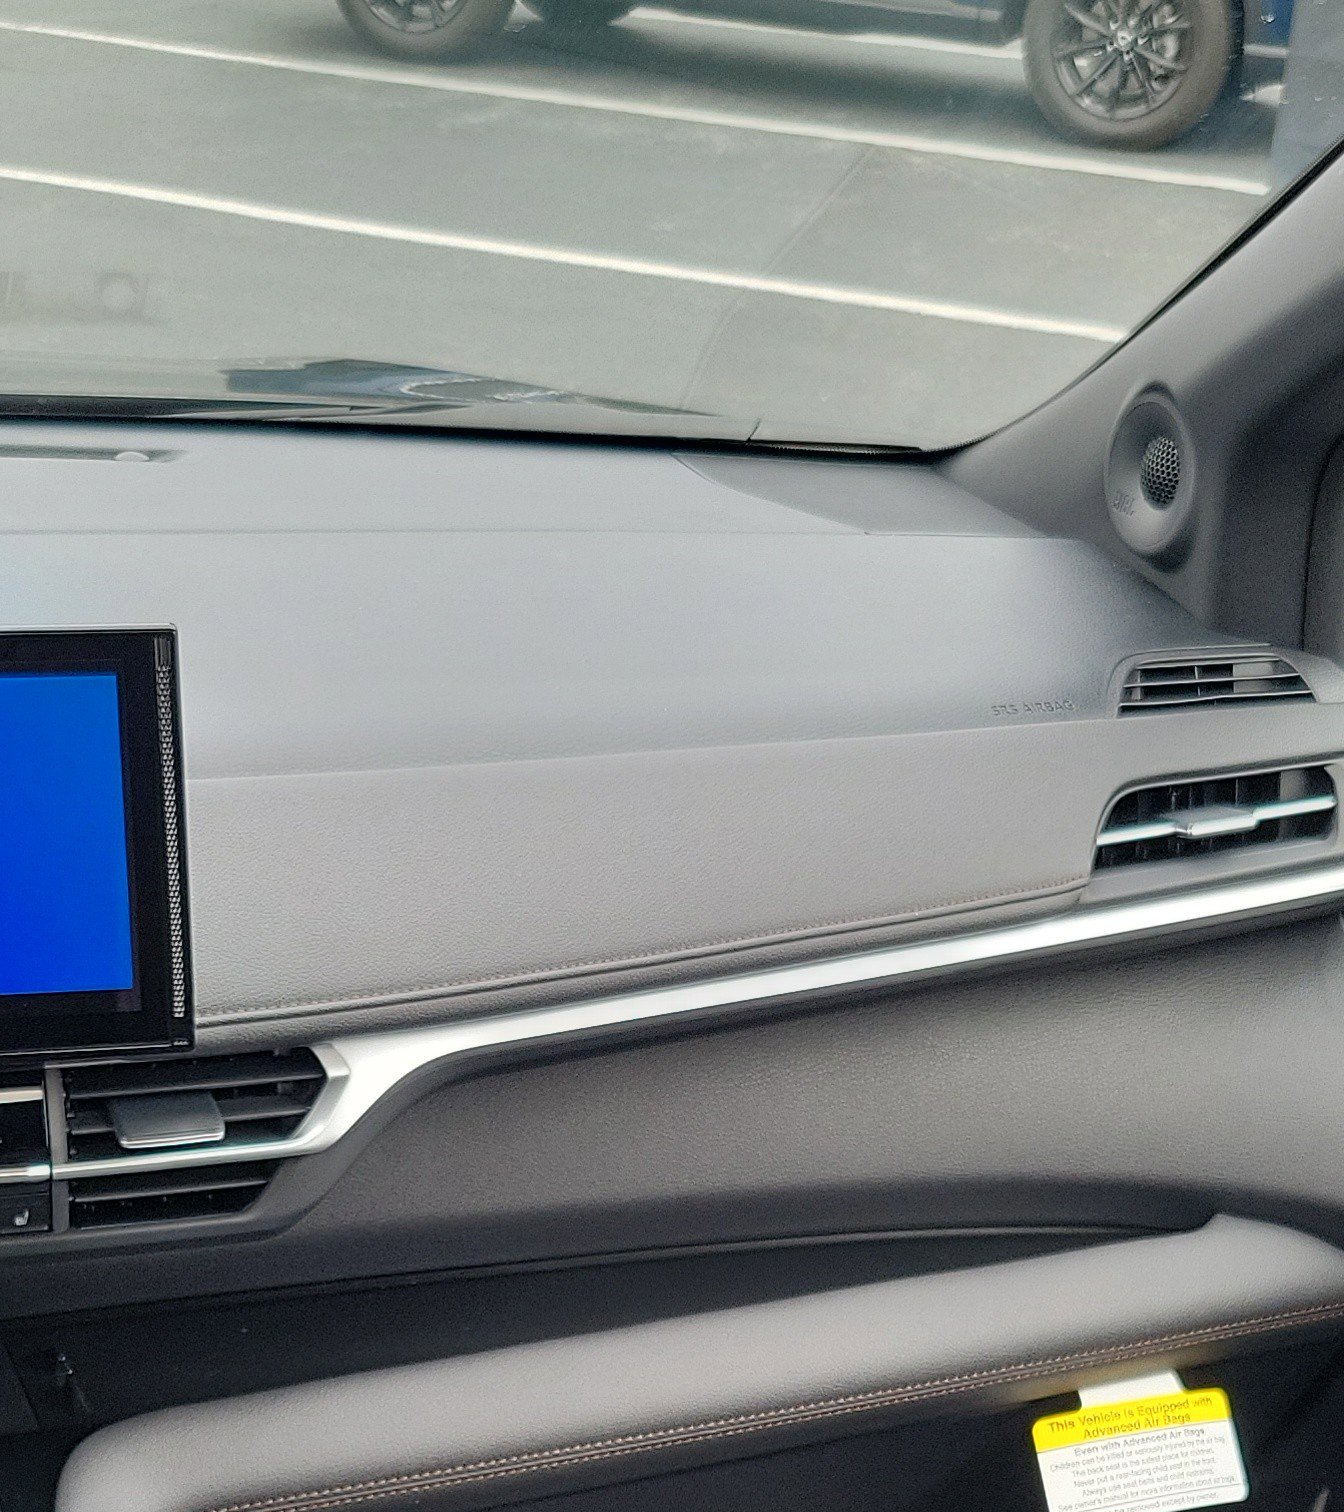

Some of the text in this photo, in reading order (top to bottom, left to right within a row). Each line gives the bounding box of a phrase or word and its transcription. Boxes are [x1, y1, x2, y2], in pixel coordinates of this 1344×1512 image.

[991, 699, 1075, 716] SRS AIRBAG
[1049, 1419, 1075, 1433] This
[1078, 1410, 1121, 1426] Vehicle
[1137, 1399, 1190, 1418] Equipped
[1193, 1397, 1213, 1407] with
[1084, 1413, 1191, 1439] Advanced Air Bags
[1074, 1428, 1205, 1457] Even with Advanced Air Bags
